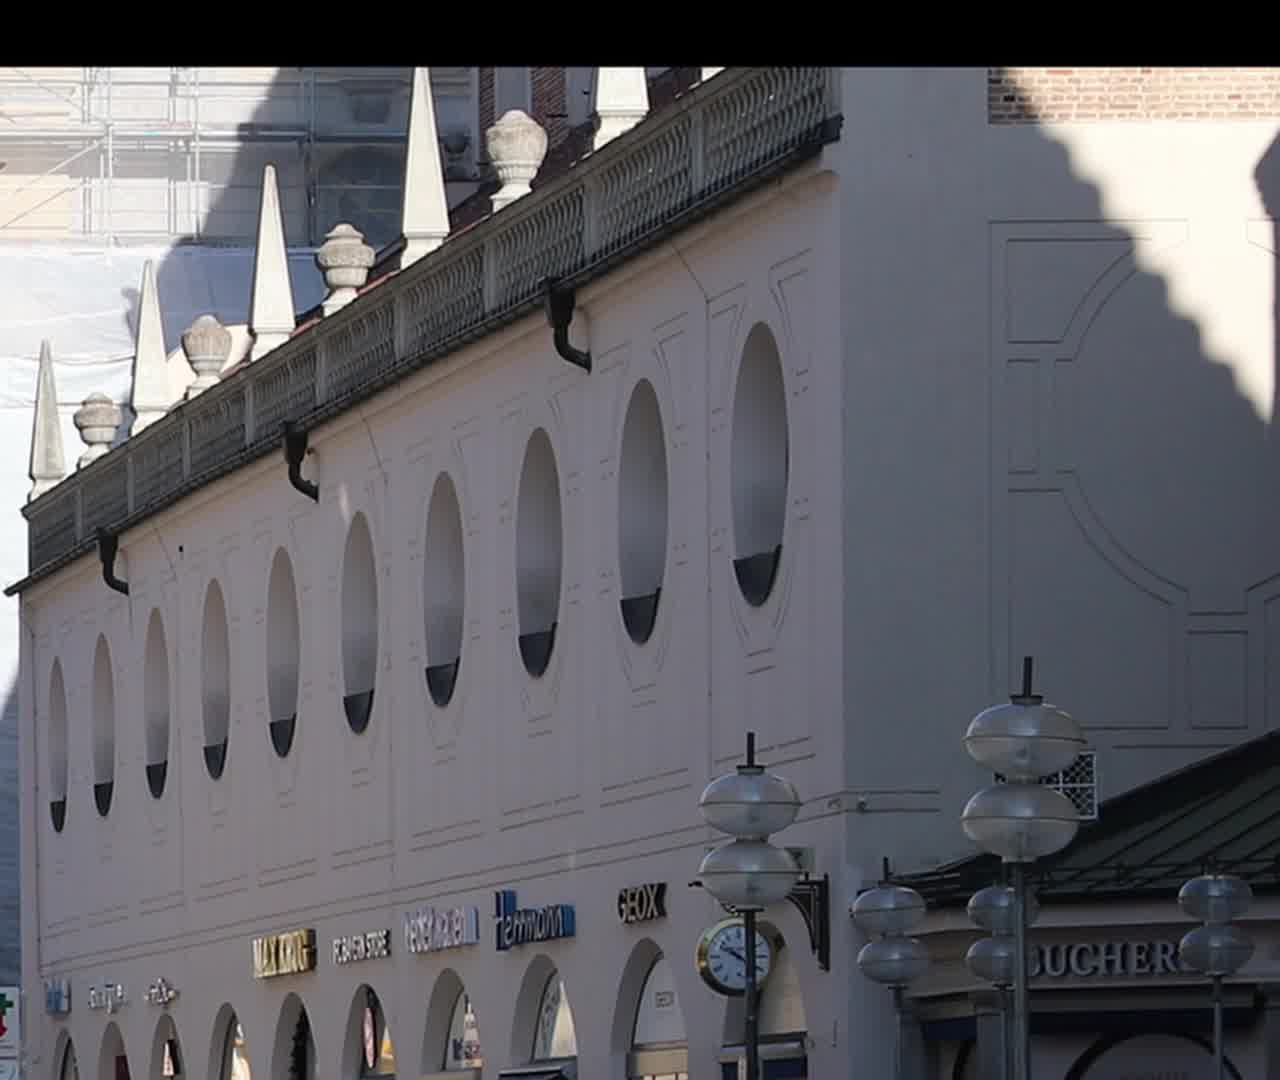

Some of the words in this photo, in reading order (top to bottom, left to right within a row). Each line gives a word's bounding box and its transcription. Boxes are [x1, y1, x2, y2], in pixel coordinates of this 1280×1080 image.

[617, 883, 665, 923] GEOX
[252, 936, 278, 978] MAX
[1031, 942, 1182, 977] UCHER
